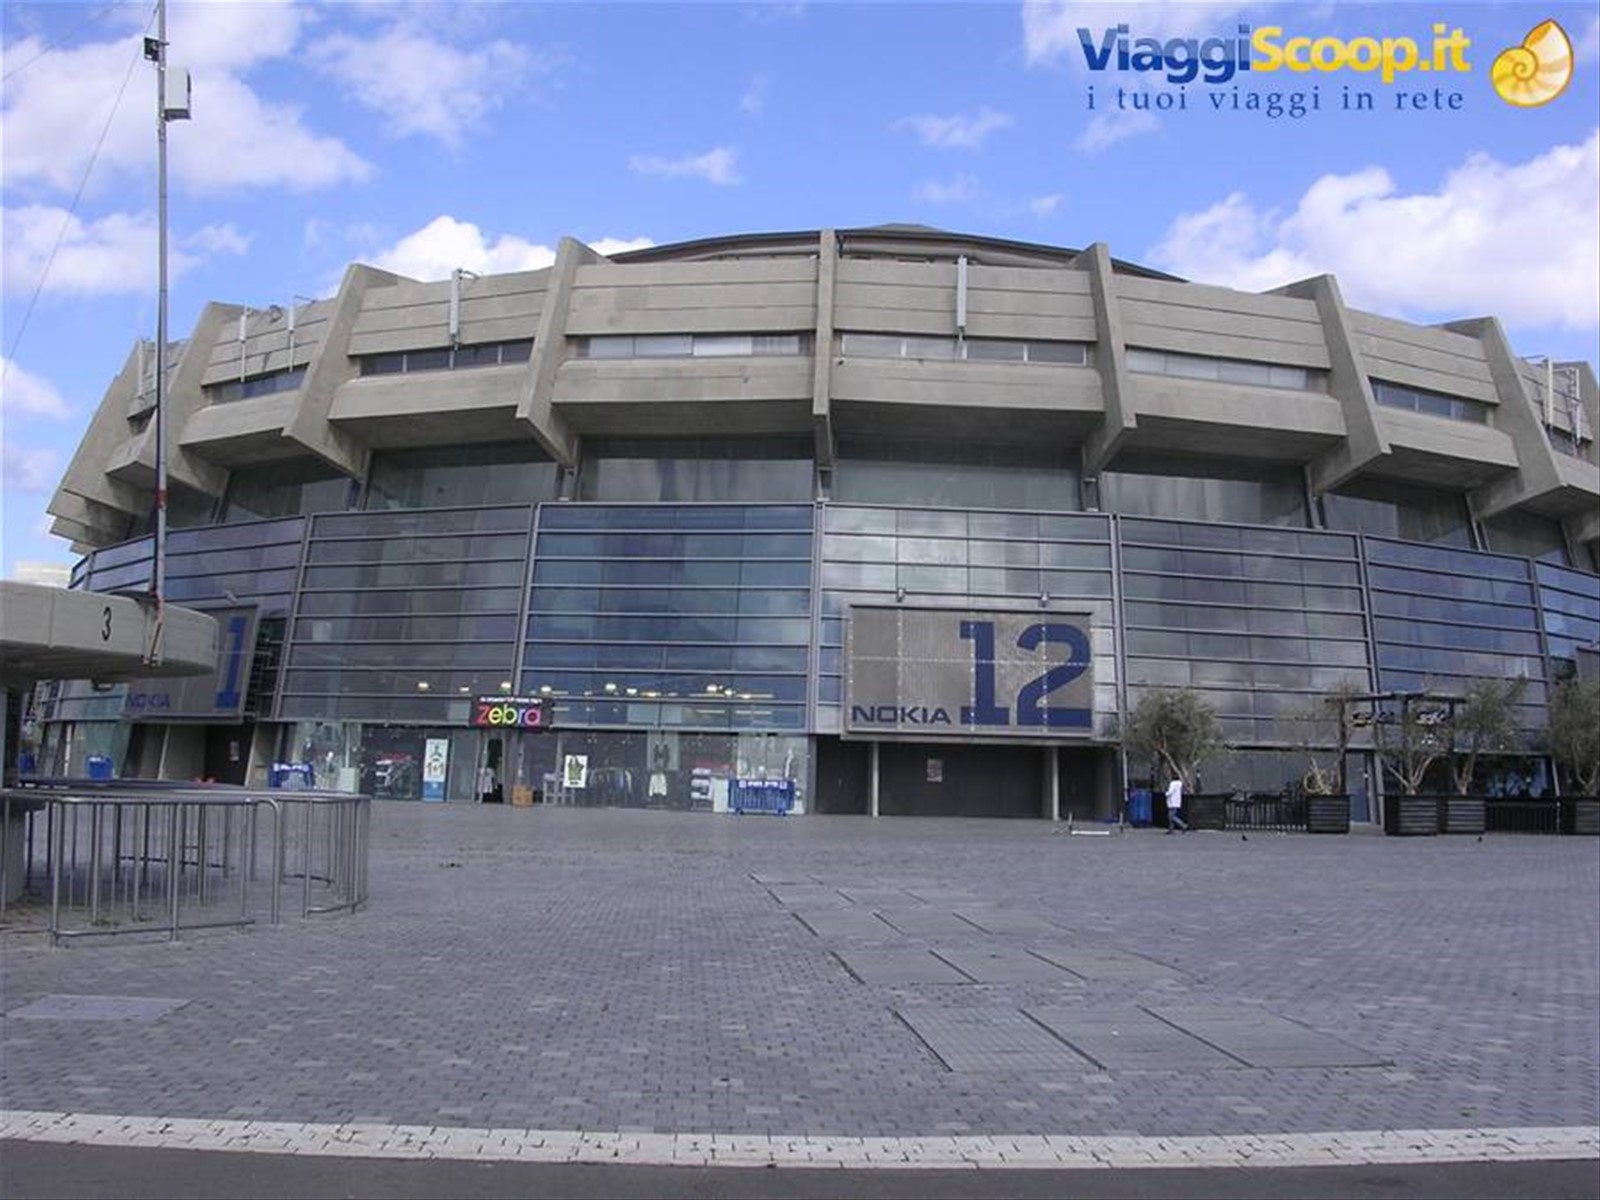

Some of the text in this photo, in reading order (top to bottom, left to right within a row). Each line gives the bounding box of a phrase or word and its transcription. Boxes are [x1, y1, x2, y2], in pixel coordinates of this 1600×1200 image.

[101, 606, 112, 641] 3
[215, 617, 246, 708] 1
[960, 622, 1092, 725] 12
[477, 703, 541, 725] zebra
[852, 706, 951, 724] NOKIA
